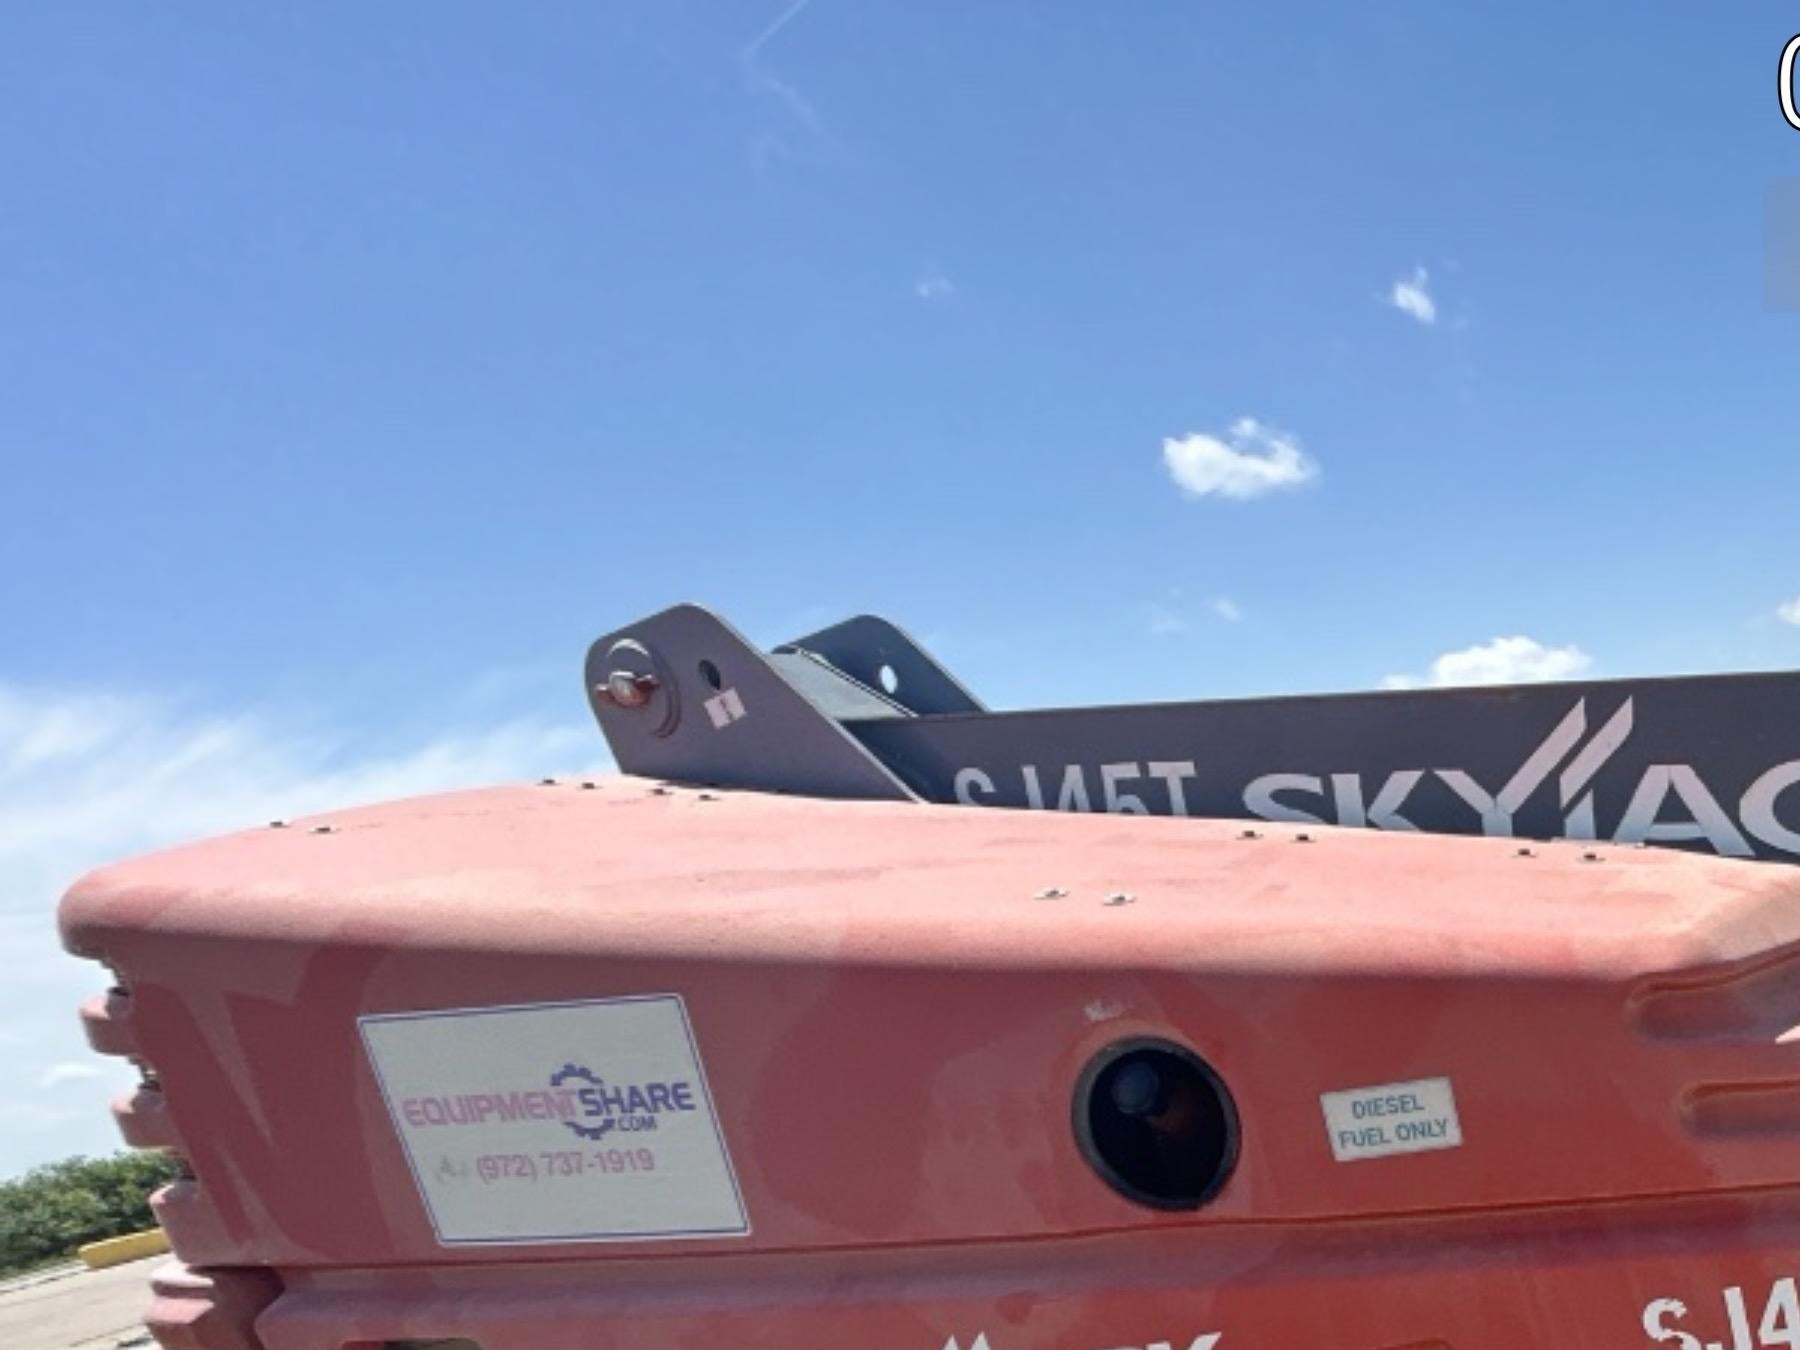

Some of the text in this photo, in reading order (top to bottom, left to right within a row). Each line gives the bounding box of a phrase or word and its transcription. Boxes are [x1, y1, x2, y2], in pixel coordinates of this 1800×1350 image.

[1352, 1094, 1425, 1119] DIESEL
[1338, 1118, 1448, 1149] FUEL ONLY
[476, 1152, 538, 1183] (972)
[541, 1147, 655, 1178] 737-1919
